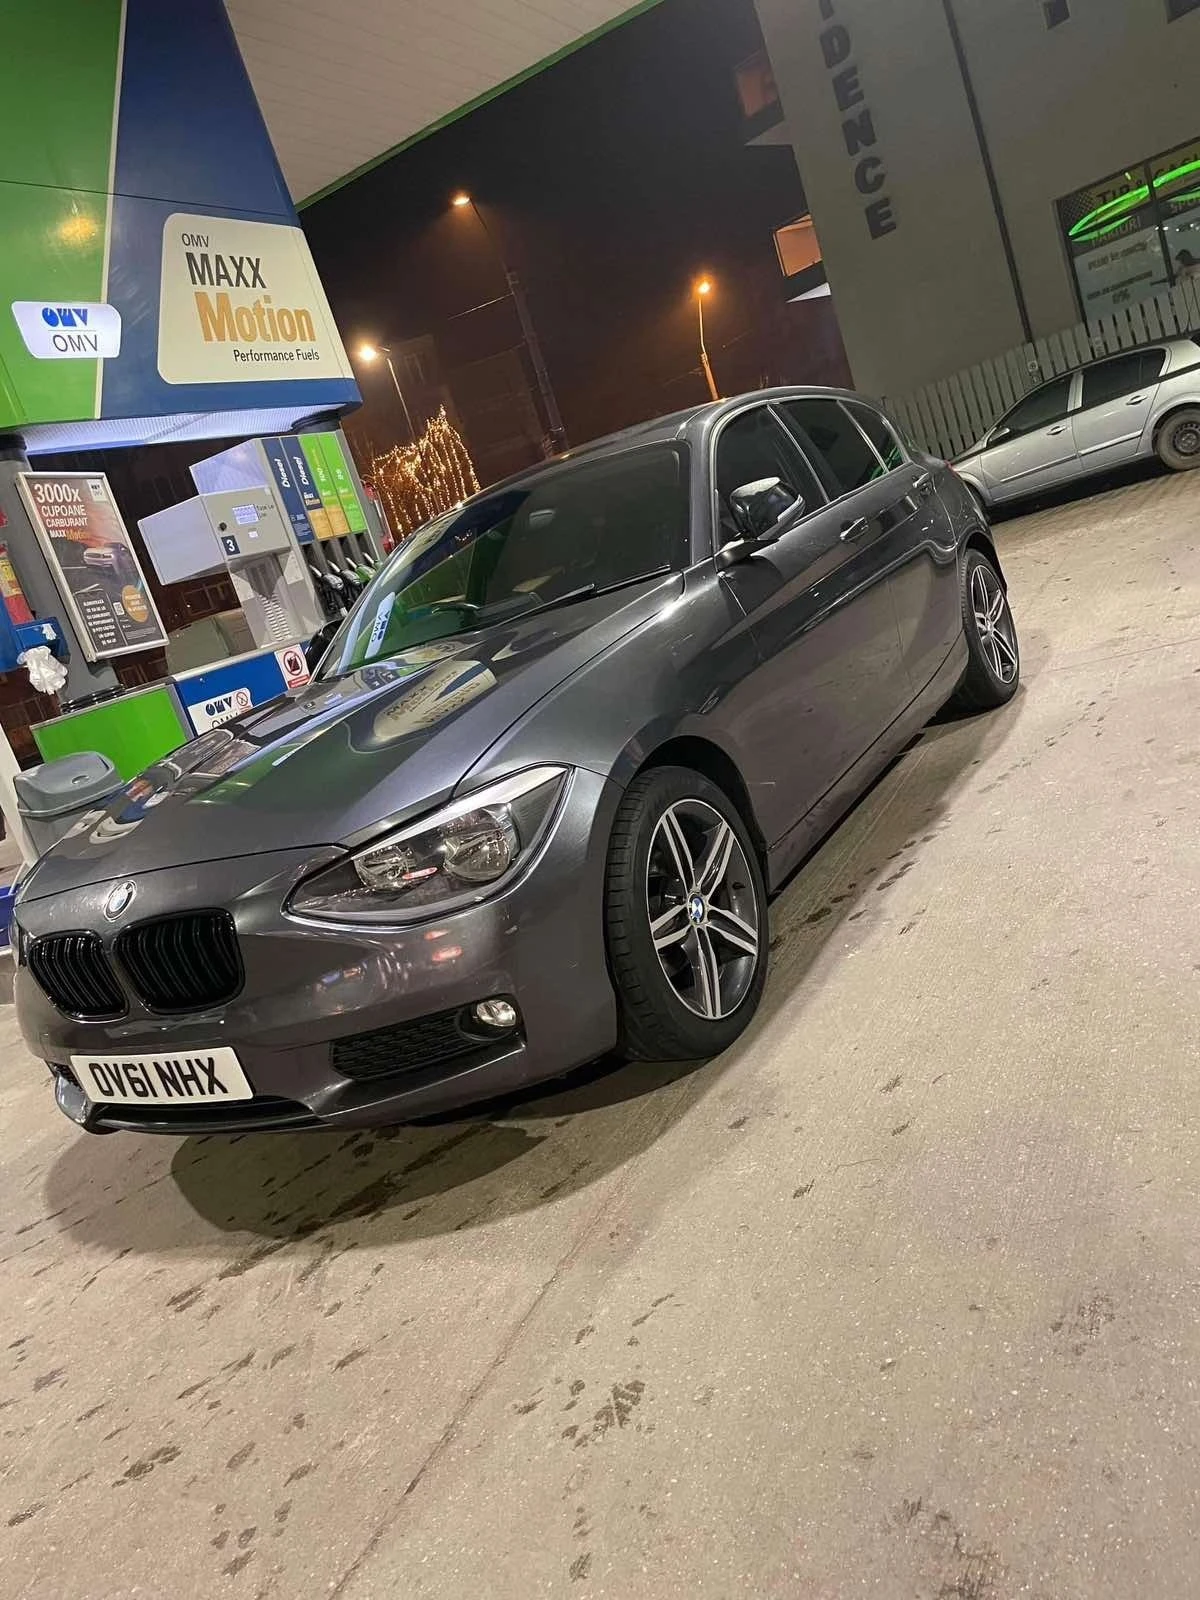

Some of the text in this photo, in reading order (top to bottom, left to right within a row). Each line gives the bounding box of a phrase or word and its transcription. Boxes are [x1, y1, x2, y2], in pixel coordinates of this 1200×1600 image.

[181, 233, 210, 249] OMV
[185, 252, 267, 289] MAXX
[194, 291, 316, 342] Motion
[52, 334, 99, 352] OMV
[233, 349, 320, 362] Performance Fuels
[274, 458, 291, 488] Diesel
[293, 456, 309, 485] Diesel
[34, 483, 81, 503] 3000x
[41, 504, 87, 517] CUPOANE
[46, 517, 88, 528] CARBURANT
[225, 539, 236, 552] 3
[88, 1057, 228, 1098] OV61 NHX
